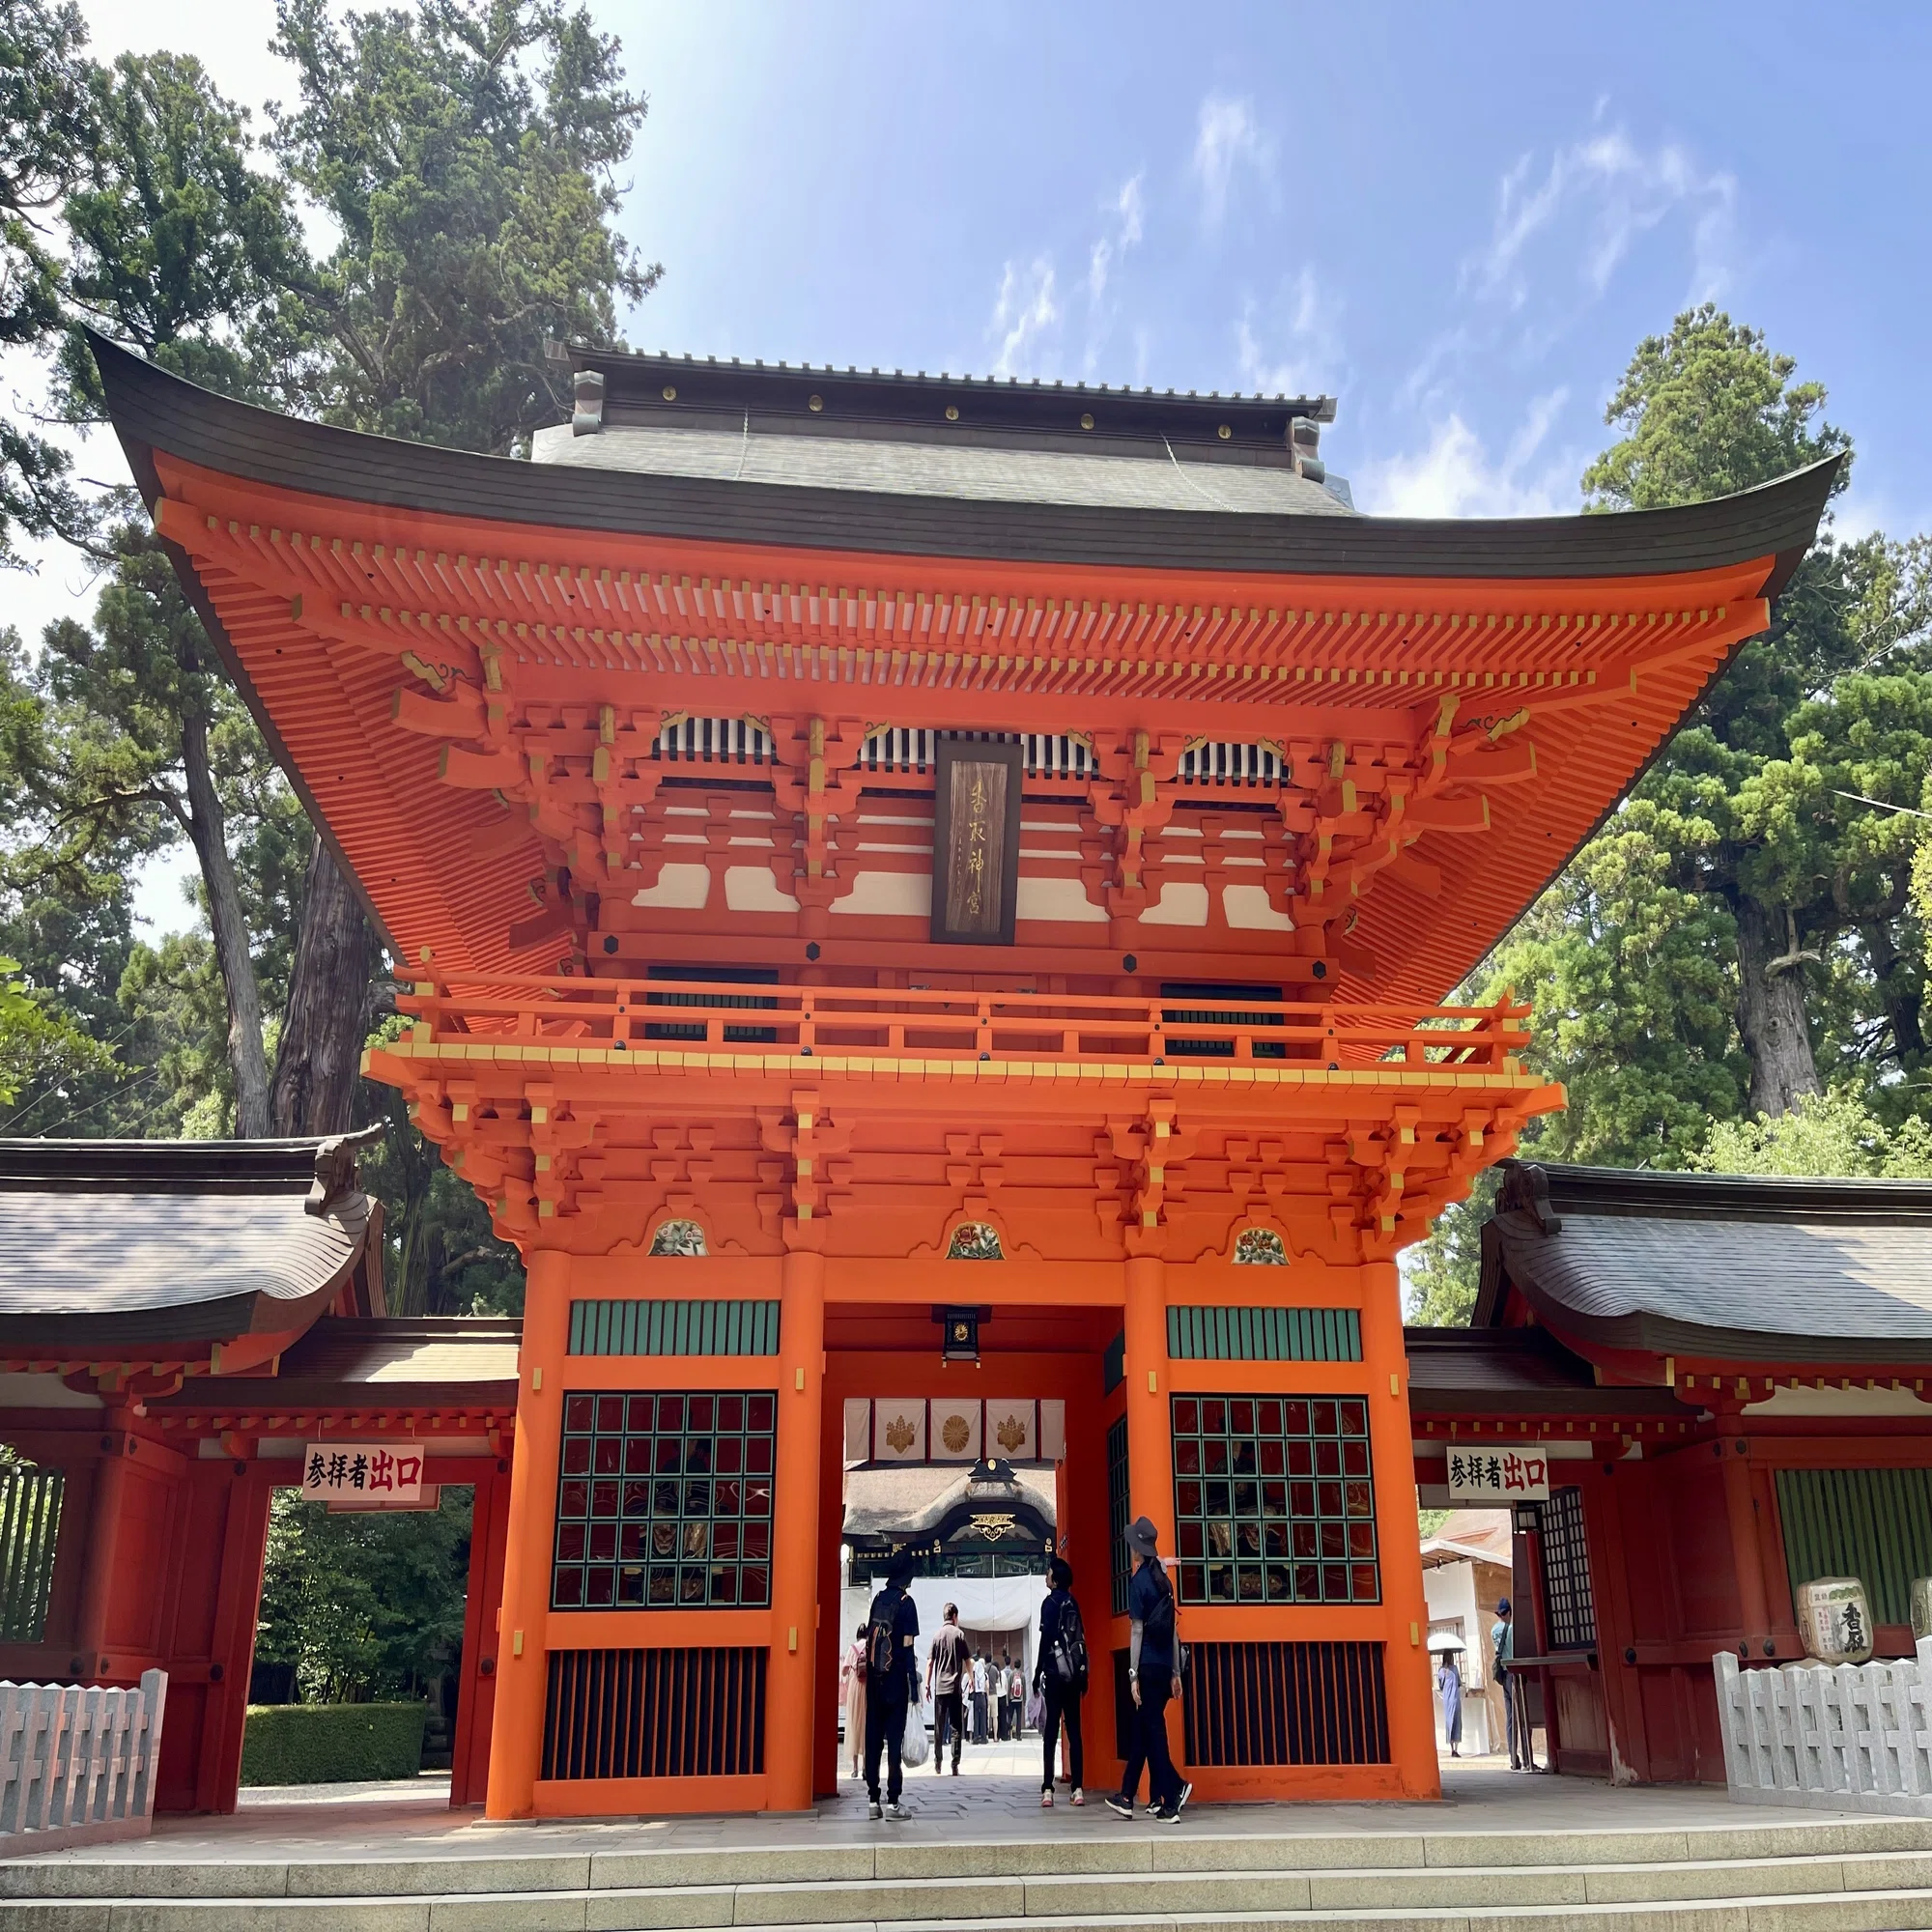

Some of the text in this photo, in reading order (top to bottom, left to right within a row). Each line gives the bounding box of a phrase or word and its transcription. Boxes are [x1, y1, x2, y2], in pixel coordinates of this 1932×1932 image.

[967, 779, 986, 915] 香取神宮
[306, 1449, 422, 1492] 参拝者出口
[1450, 1452, 1546, 1492] 参拝者出口
[1840, 1602, 1868, 1653] 香取
